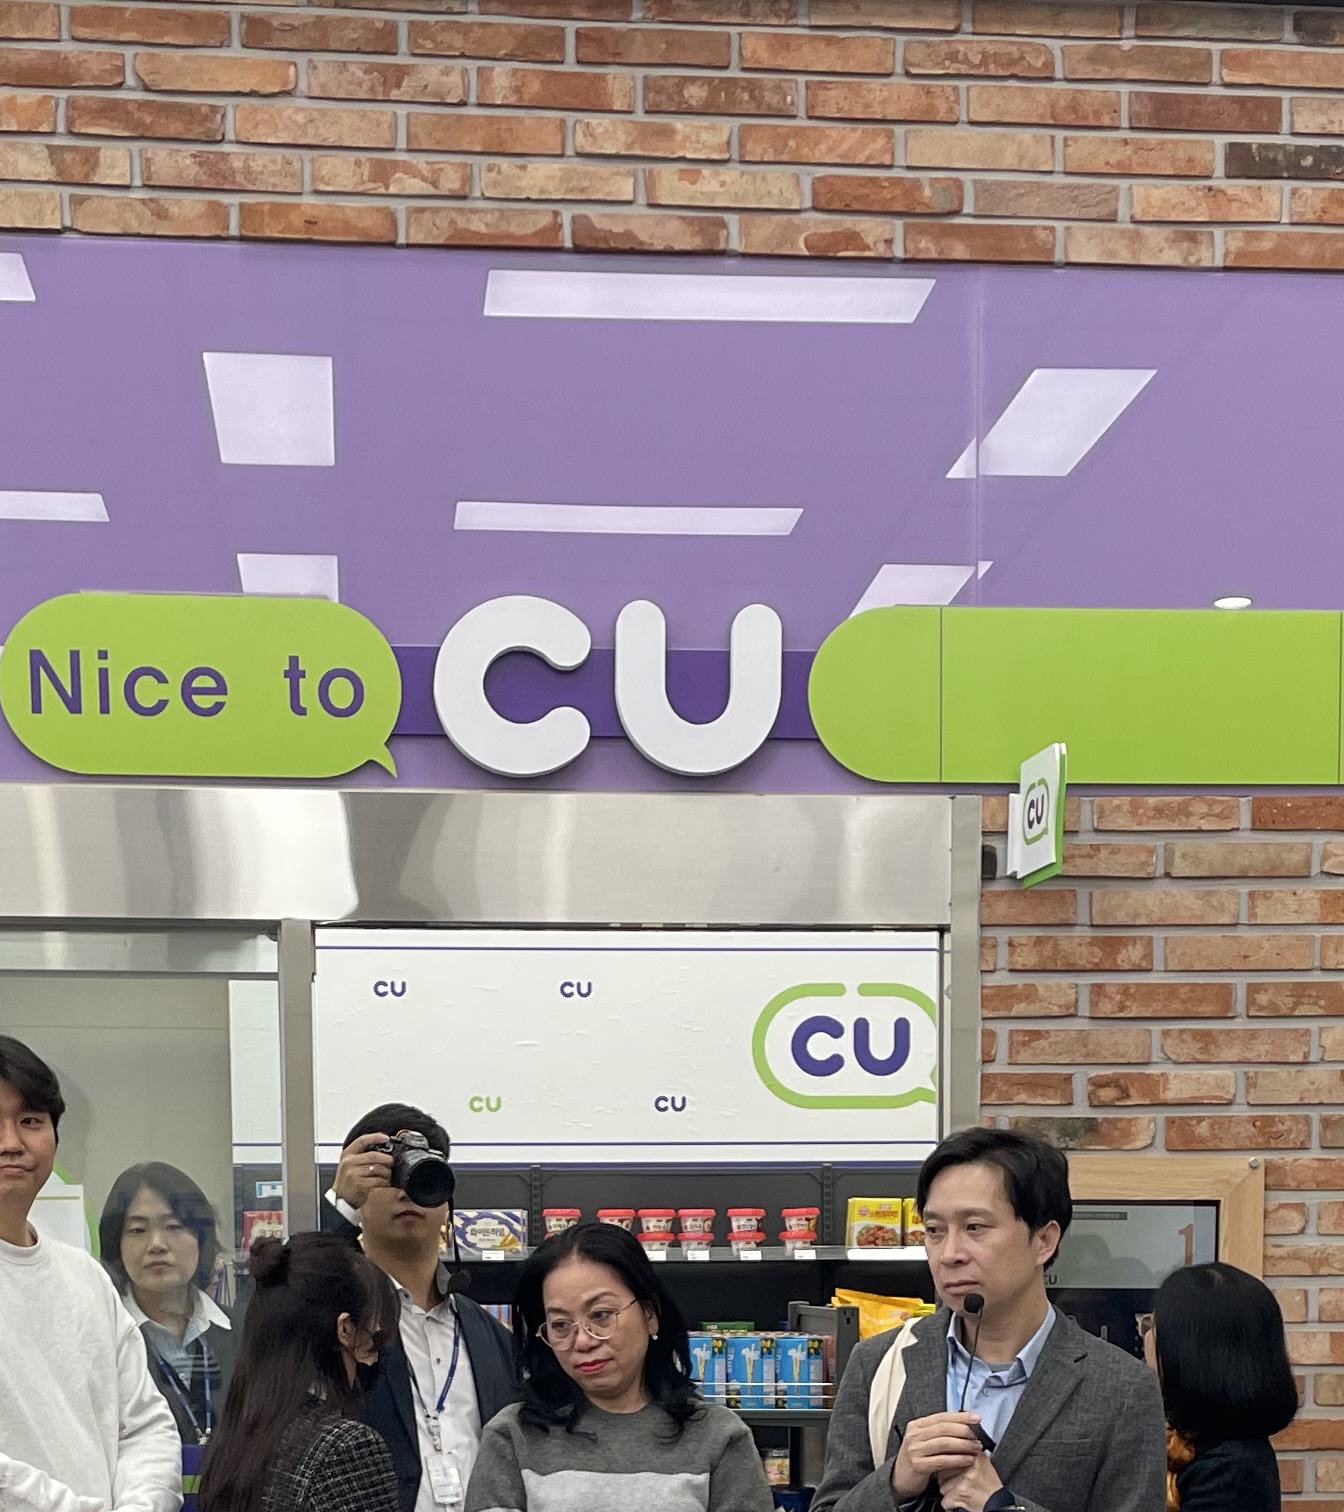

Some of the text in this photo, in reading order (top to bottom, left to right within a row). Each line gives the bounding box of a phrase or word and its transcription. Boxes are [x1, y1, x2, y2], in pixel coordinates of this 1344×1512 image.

[28, 595, 783, 777] Nice to CU
[1027, 794, 1045, 830] CU
[373, 980, 407, 998] CU
[559, 981, 593, 999] CU
[791, 1015, 911, 1077] CU
[468, 1095, 502, 1113] CU
[654, 1095, 687, 1113] CU
[1178, 1223, 1194, 1266] 1
